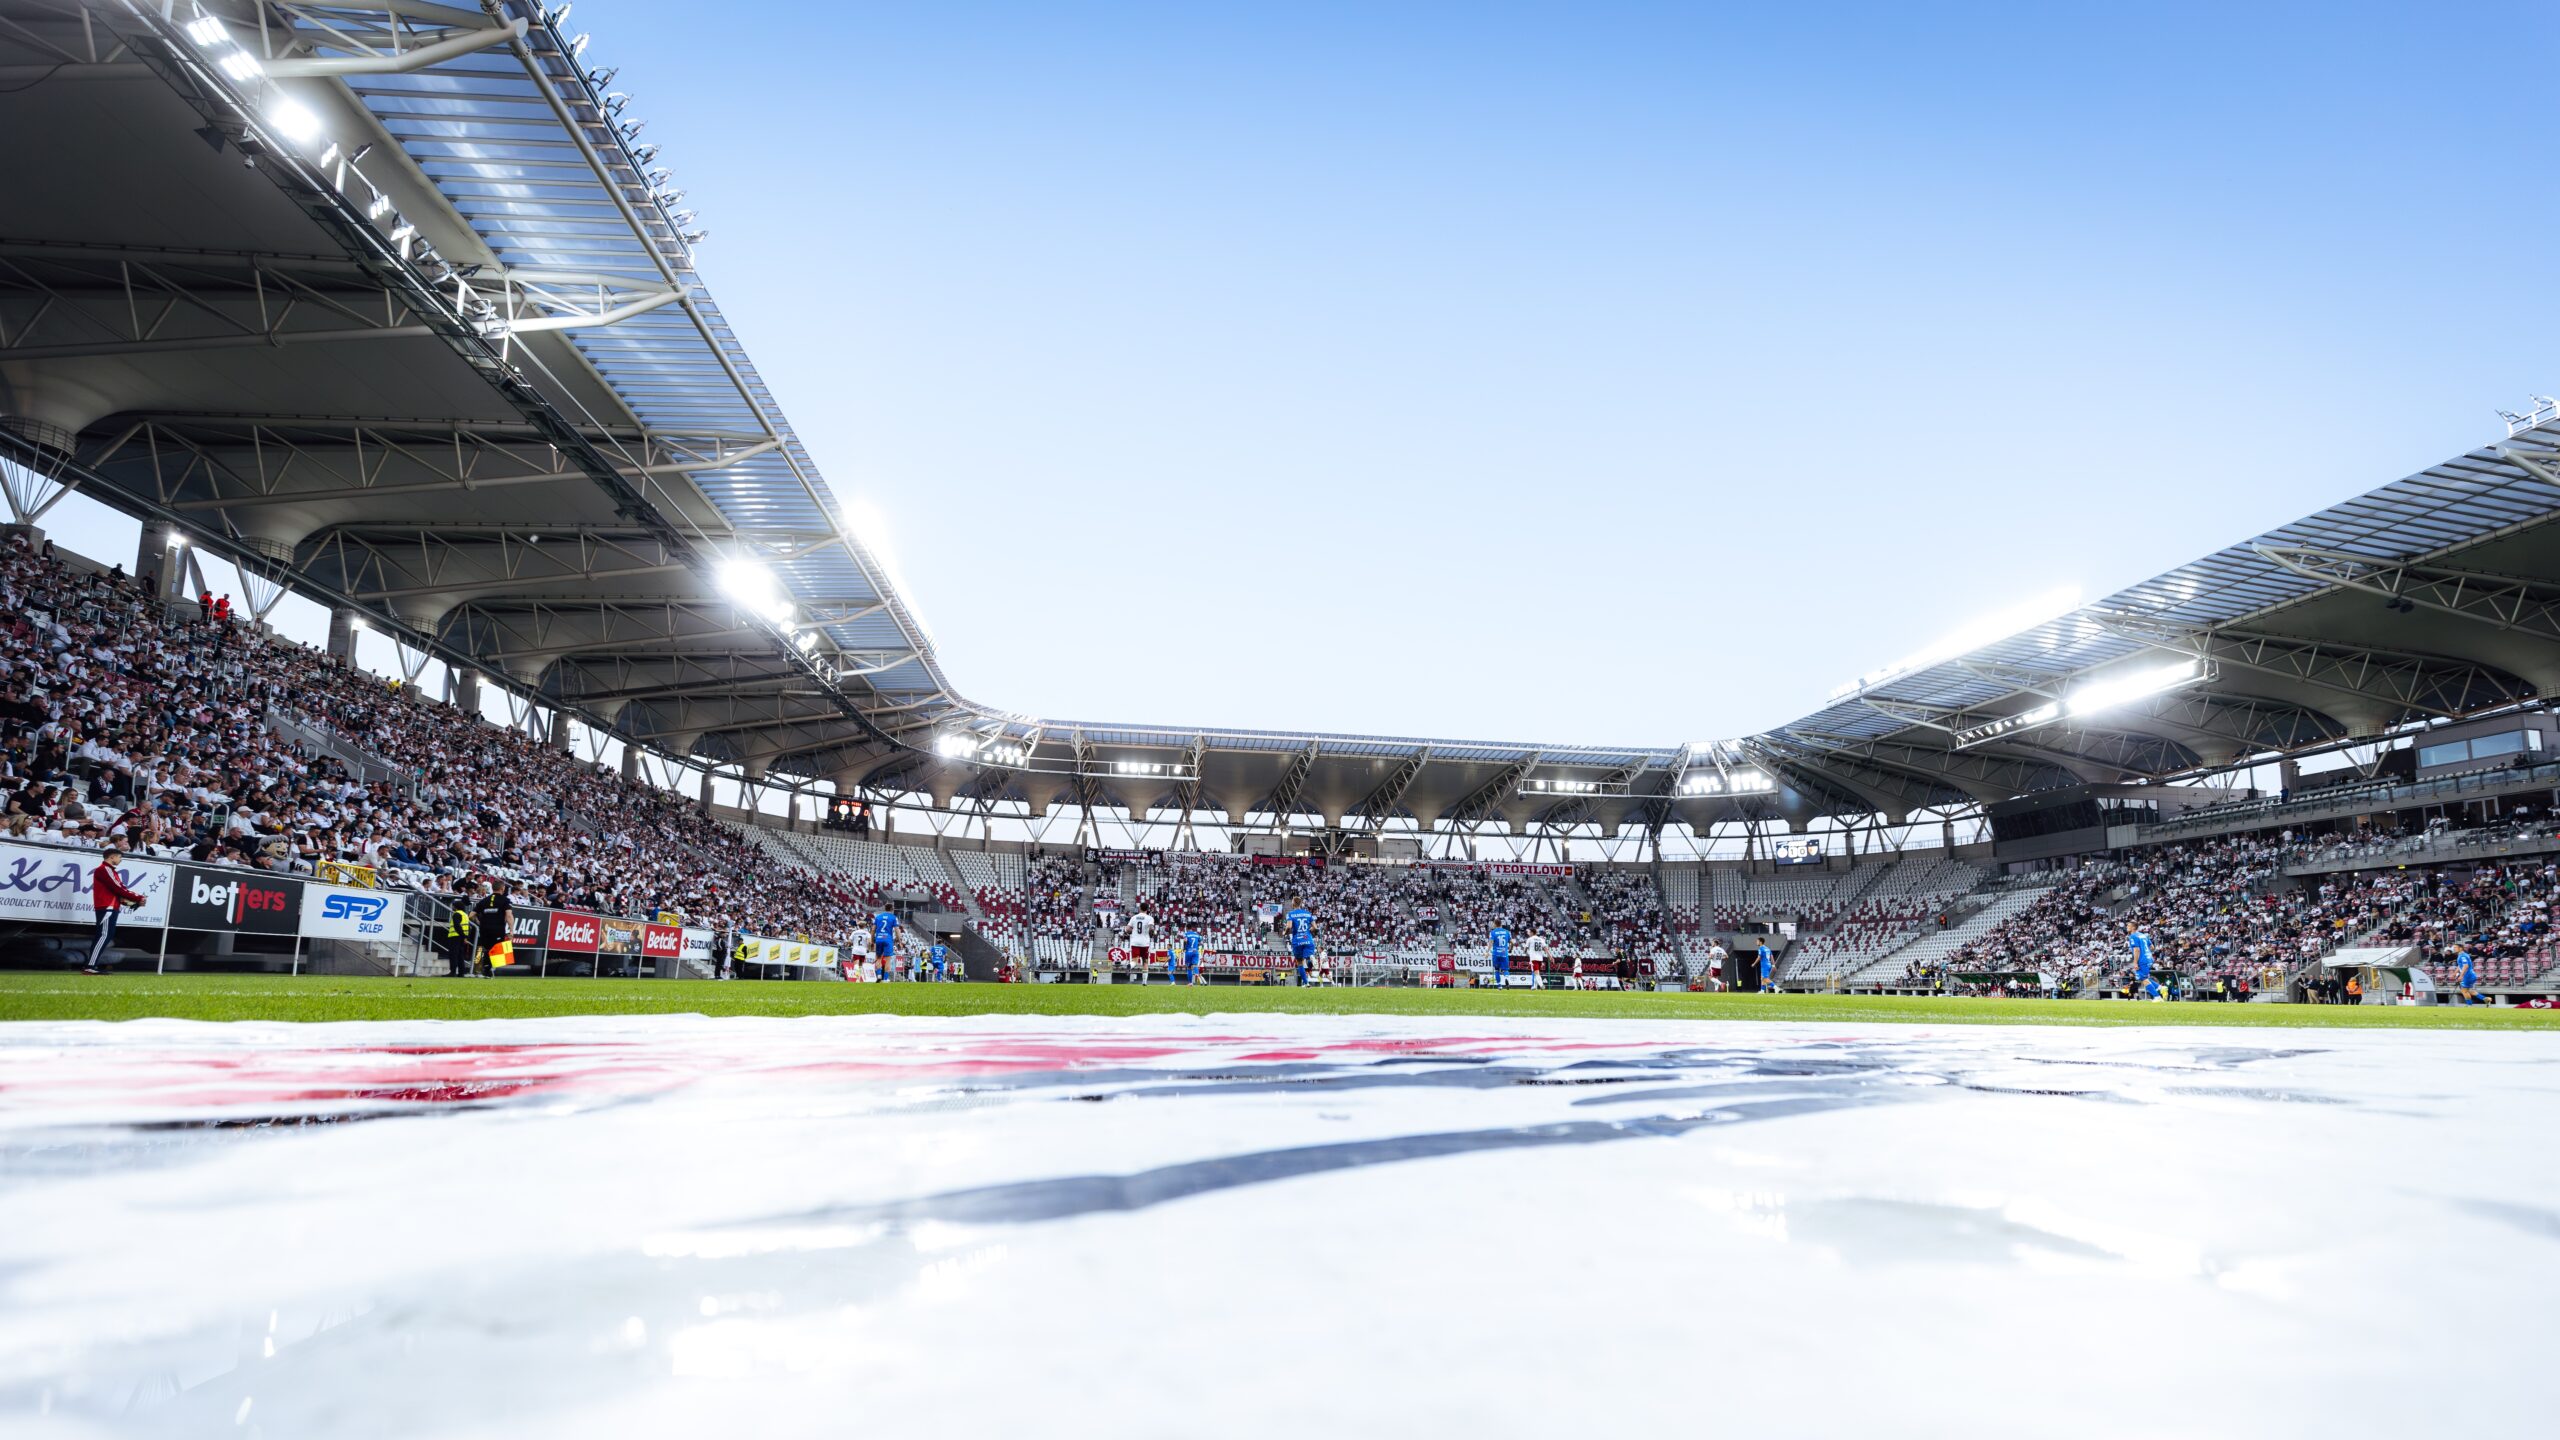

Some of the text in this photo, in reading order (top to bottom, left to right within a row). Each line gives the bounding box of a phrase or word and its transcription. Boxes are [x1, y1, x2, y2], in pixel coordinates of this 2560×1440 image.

[1494, 864, 1564, 875] TEOFILÓW
[44, 899, 75, 911] TKANIN
[190, 875, 286, 925] betters
[358, 922, 383, 934] SKLEP
[880, 920, 888, 933] 2
[1136, 921, 1143, 935] 9
[1297, 918, 1308, 932] 26
[554, 919, 596, 944] Betclic
[647, 931, 678, 951] Betclic
[858, 935, 863, 946] 2
[1190, 937, 1196, 949] 7
[1497, 935, 1506, 947] 16
[1456, 955, 1492, 967] Wiosn
